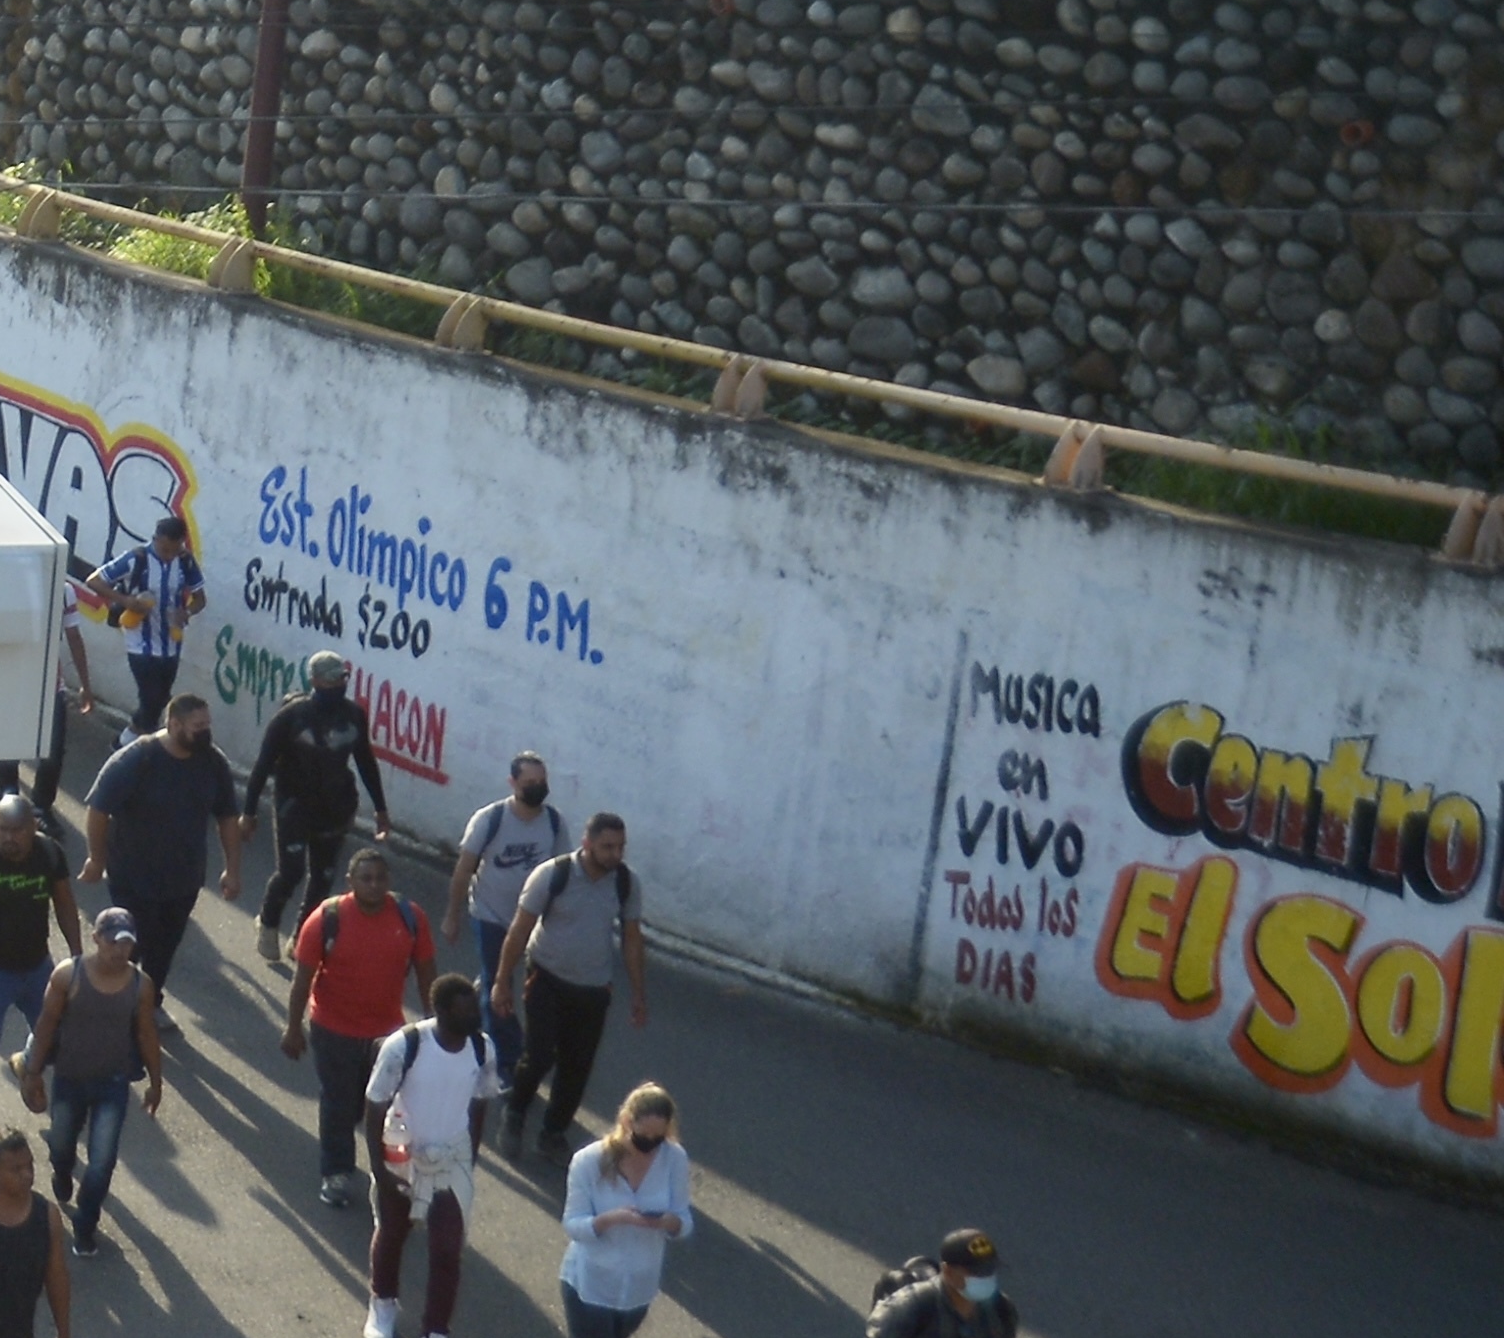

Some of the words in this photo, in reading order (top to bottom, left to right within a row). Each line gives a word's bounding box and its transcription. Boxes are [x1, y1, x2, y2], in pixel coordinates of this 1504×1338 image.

[246, 556, 343, 639] Entrada
[357, 588, 432, 658] $200
[260, 465, 318, 557] Est.
[328, 484, 466, 612] Olimpico
[483, 556, 512, 629] 6
[527, 581, 604, 665] P.M.
[345, 662, 449, 772] HACON
[997, 749, 1049, 801] en
[1121, 700, 1487, 904] Centro
[956, 796, 1085, 877] VIVO
[955, 938, 1037, 1004] DIAS
[1094, 854, 1240, 1021] El
